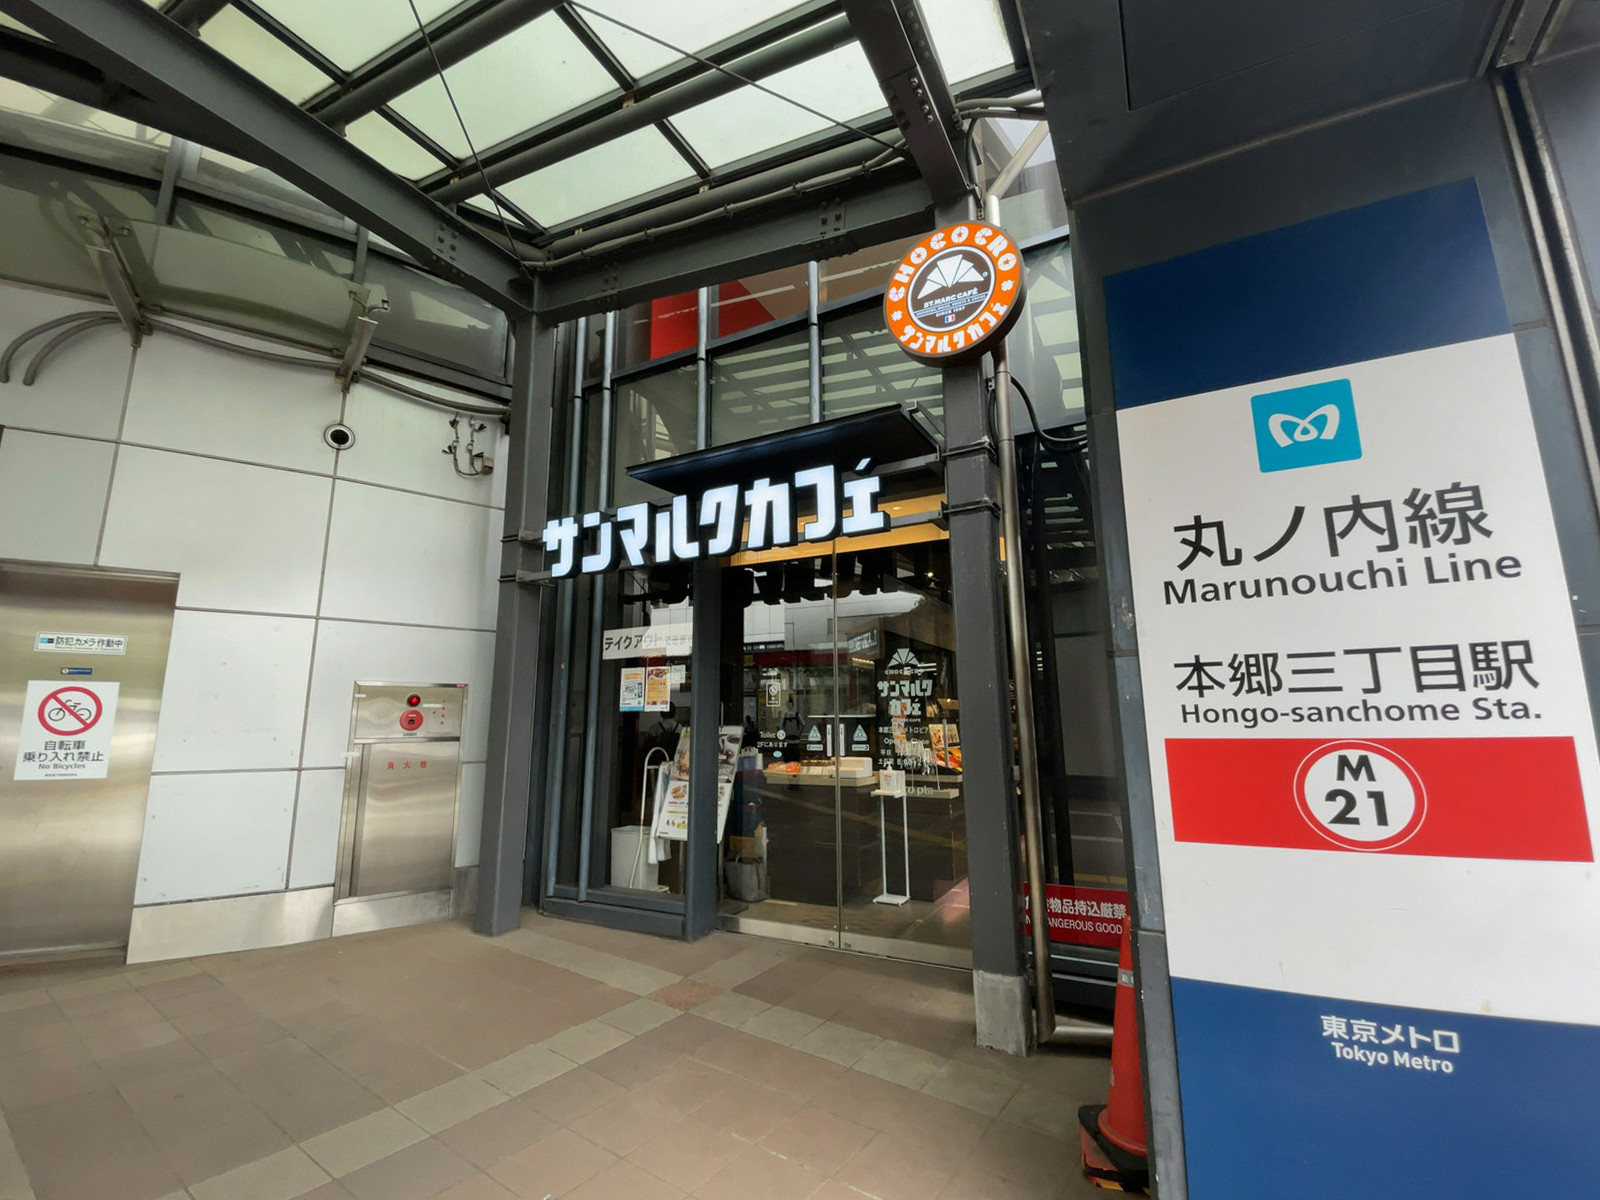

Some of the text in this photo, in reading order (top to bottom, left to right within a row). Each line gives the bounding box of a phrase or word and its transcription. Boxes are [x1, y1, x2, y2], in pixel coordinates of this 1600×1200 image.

[888, 226, 1017, 302] CHOCOCRO
[543, 458, 885, 578] サンマルクカフェ
[1173, 481, 1494, 571] 丸ノ内線
[1163, 552, 1523, 605] Marunouchi Line
[55, 636, 123, 648] 防犯カメラ作動中
[1173, 639, 1540, 698] 本郷三丁目駅
[877, 679, 933, 697] サンマルク
[1180, 696, 1542, 729] Hongo-sanchome Sta.
[22, 751, 104, 763] 乗り入れ禁止
[44, 740, 86, 751] 自転車
[53, 763, 86, 771] Bicycles
[1336, 754, 1376, 782] M
[1324, 788, 1389, 827] 21
[1320, 1014, 1461, 1054] 東京メトロ
[1331, 1041, 1454, 1074] Tokyo Metro
